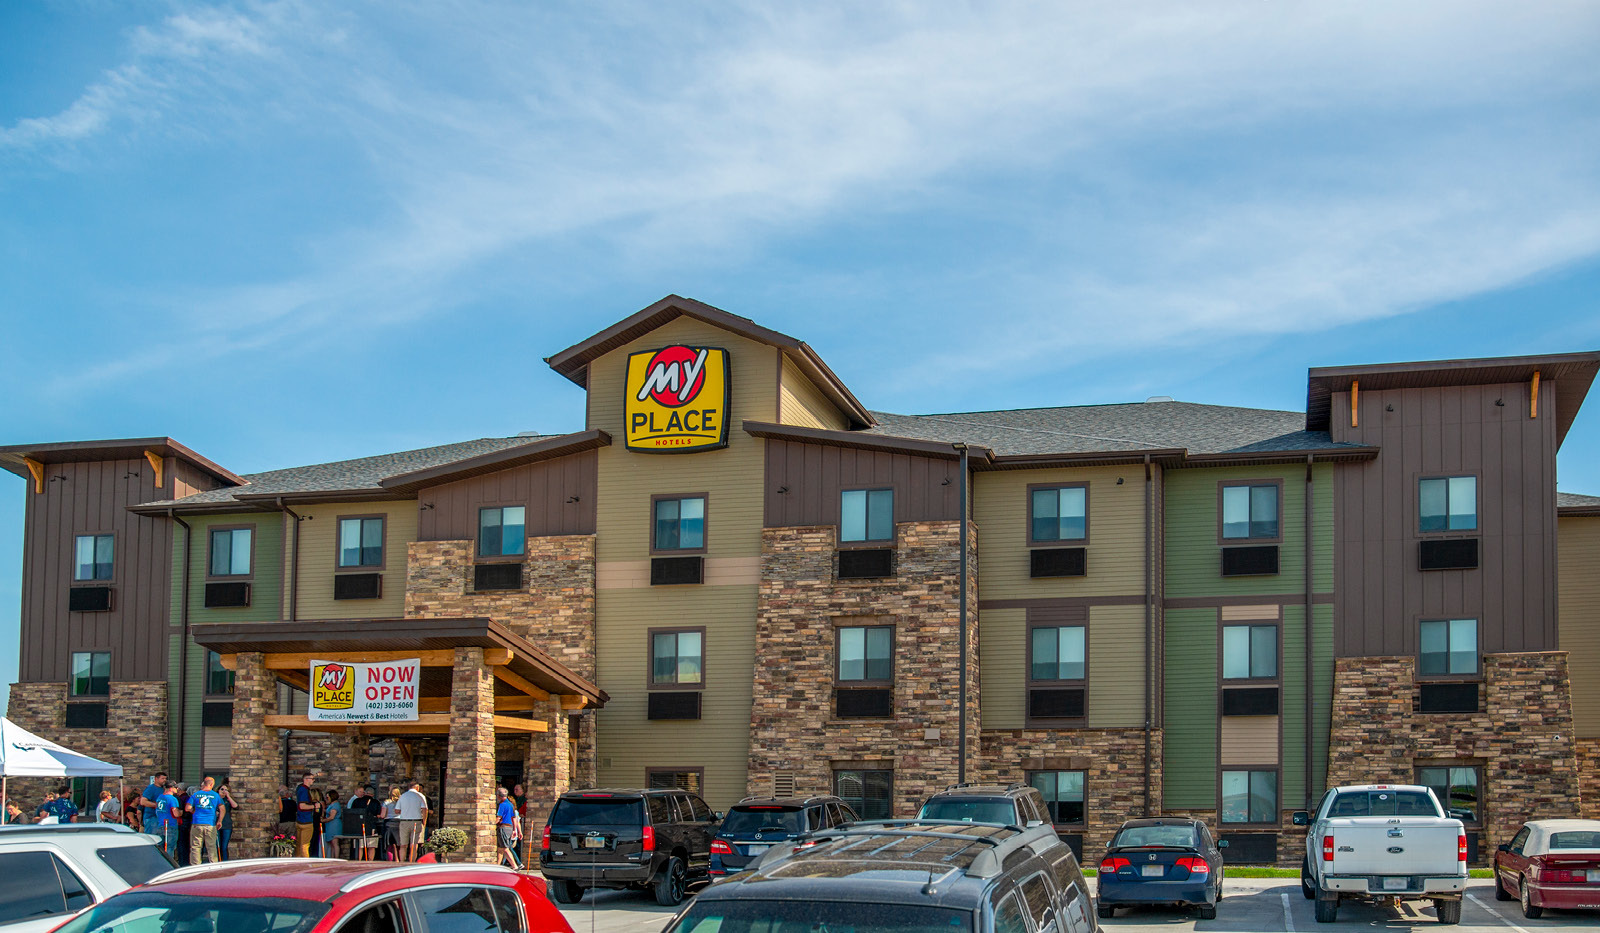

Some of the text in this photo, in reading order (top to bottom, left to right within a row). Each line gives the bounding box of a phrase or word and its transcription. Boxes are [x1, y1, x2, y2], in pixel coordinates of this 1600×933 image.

[631, 409, 717, 433] PLACE
[655, 438, 692, 446] HOTELS
[367, 666, 415, 683] NOW
[316, 691, 352, 702] PLACE
[365, 686, 415, 700] OPEN
[365, 701, 414, 710] (402) 303-6060
